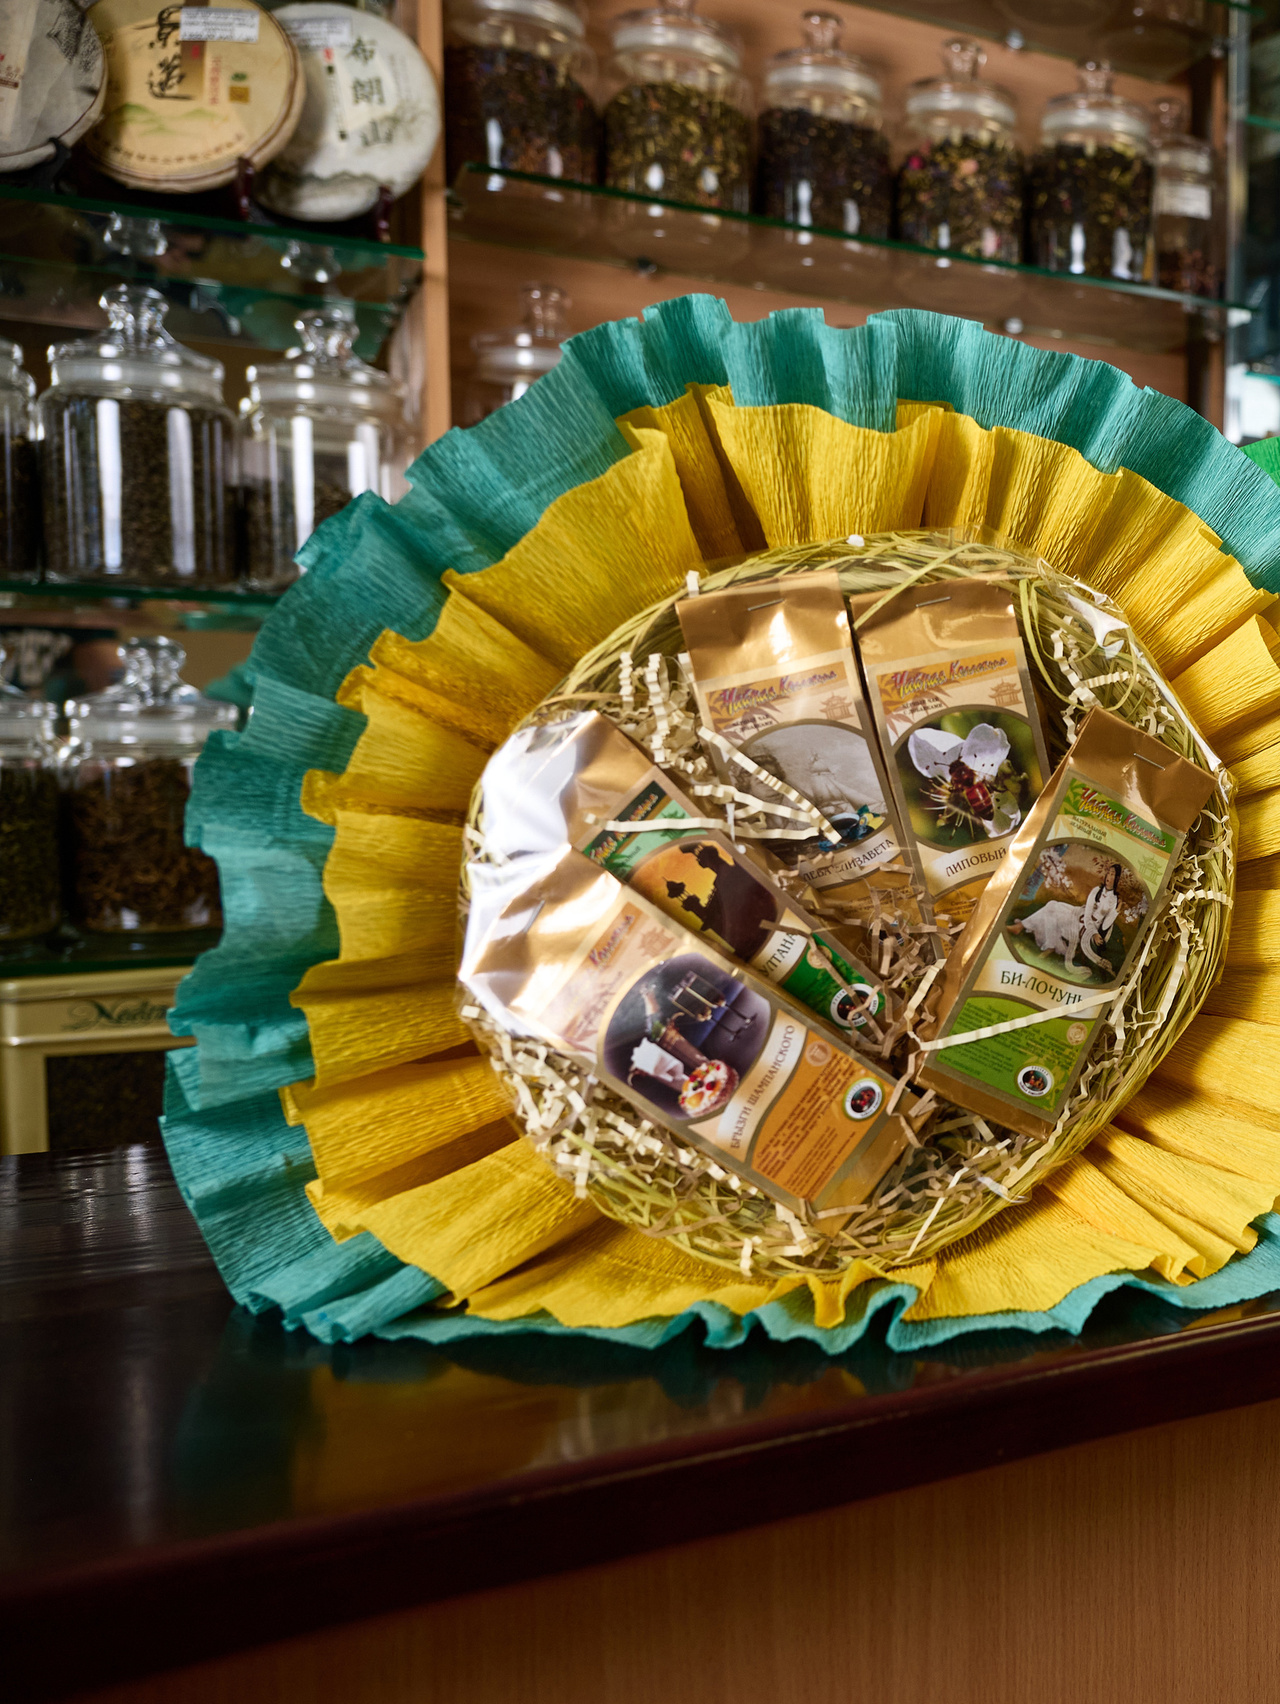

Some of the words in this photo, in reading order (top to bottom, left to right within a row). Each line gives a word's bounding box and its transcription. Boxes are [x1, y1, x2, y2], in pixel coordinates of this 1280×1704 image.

[1079, 787, 1123, 825] Чайная
[945, 846, 1007, 877] ЛИПОВЫЙ
[758, 931, 799, 977] УЛТАНА
[731, 1105, 752, 1150] БРЫЗГИ
[748, 1025, 796, 1112] ШАМПАНСКОГО
